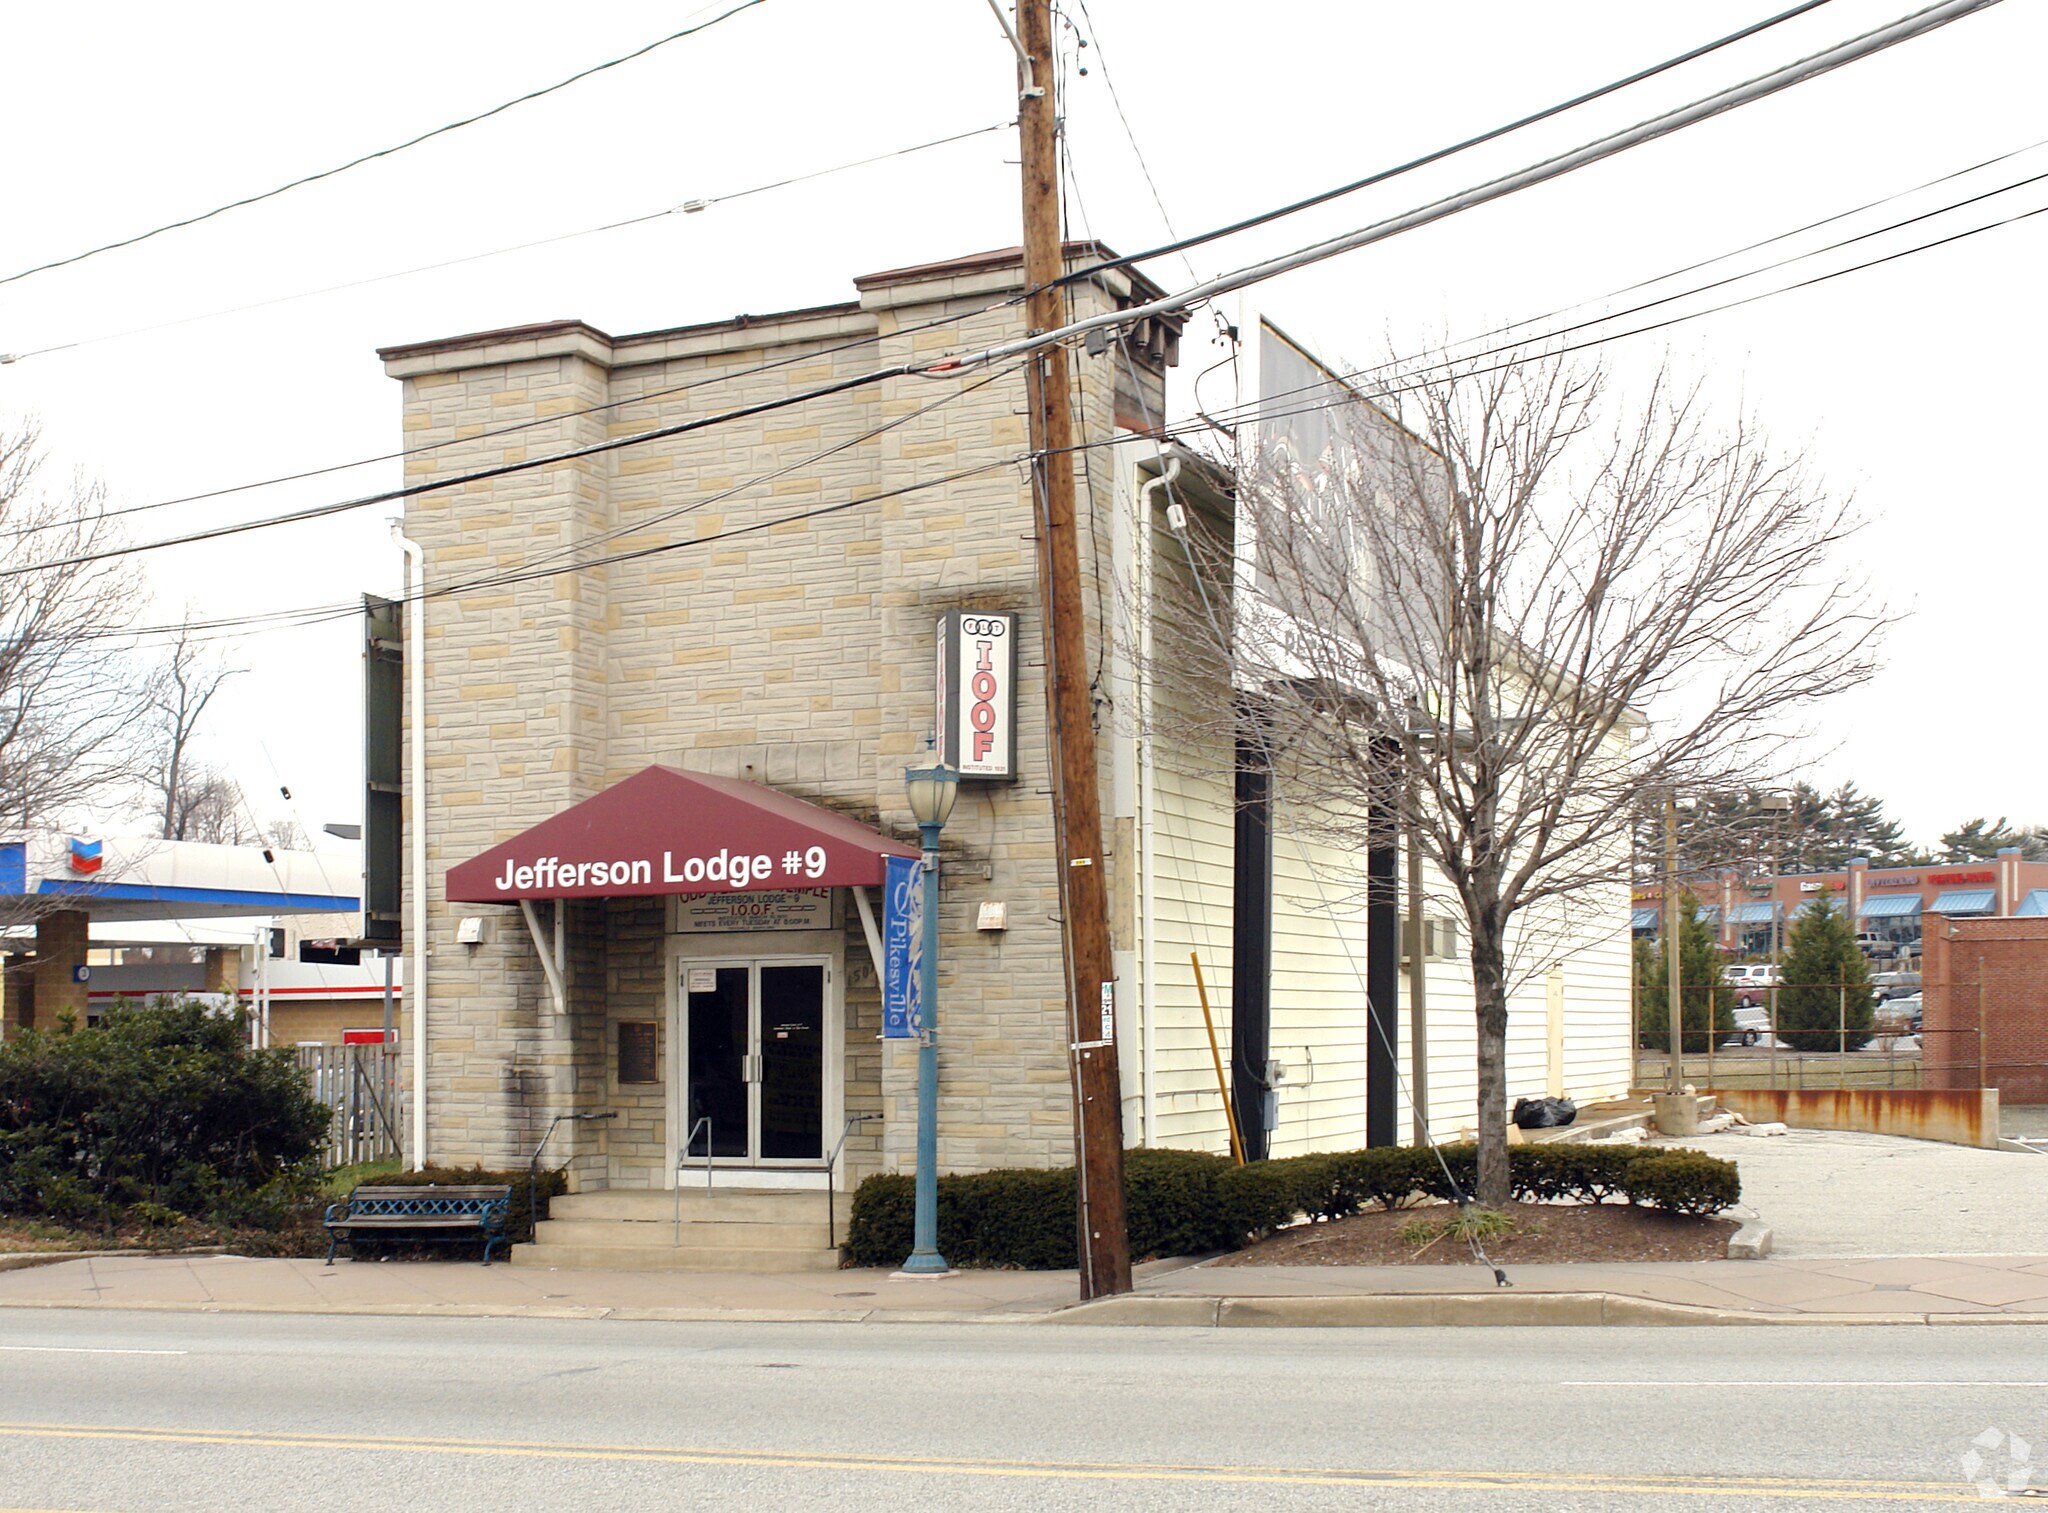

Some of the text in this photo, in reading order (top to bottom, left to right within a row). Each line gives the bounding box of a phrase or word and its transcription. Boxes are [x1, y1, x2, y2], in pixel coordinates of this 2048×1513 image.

[971, 640, 997, 761] IOOF
[495, 846, 826, 890] Jefferson Lodge #9
[707, 895, 754, 905] JEFFERSON
[758, 894, 786, 903] LODGE
[780, 887, 829, 899] EMPLE
[731, 903, 774, 916] I.O.O.F.
[889, 918, 907, 1026] Pikesville
